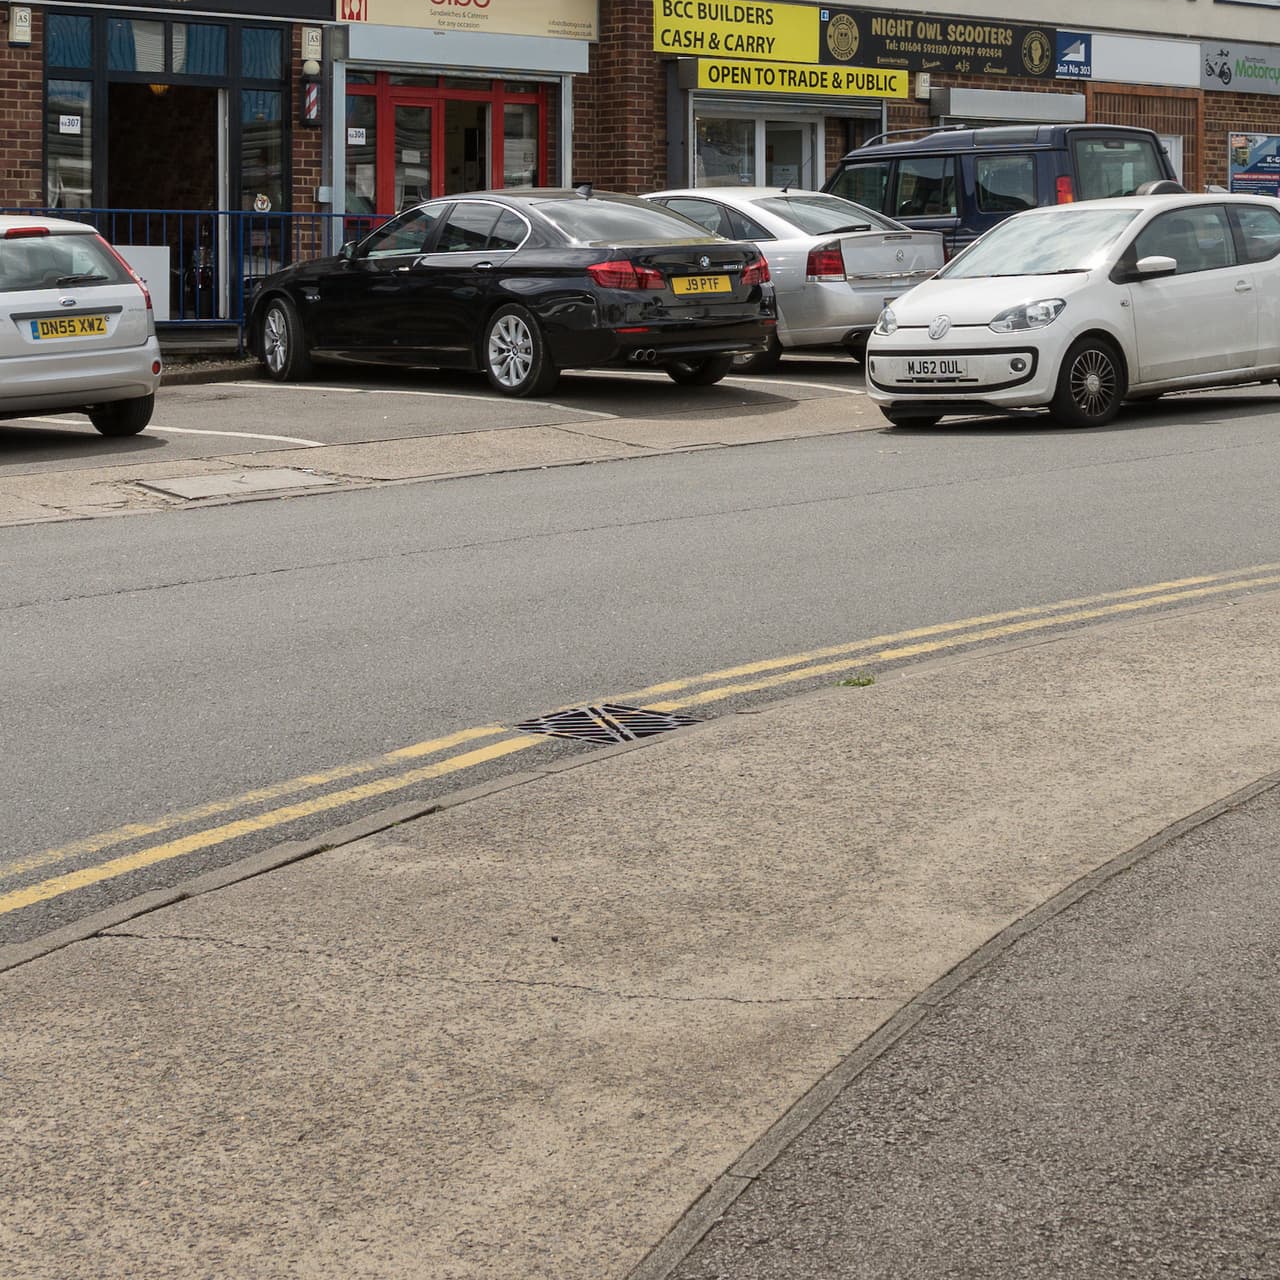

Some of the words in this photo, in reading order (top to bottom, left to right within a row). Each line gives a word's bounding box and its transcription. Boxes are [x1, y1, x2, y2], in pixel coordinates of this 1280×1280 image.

[430, 9, 461, 18] Sandwiches
[467, 11, 488, 20] Caterers
[663, 0, 693, 18] BCC
[698, 3, 774, 25] BUILDERS
[446, 21, 456, 30] any
[872, 18, 914, 37] NIGHT
[917, 21, 943, 41] OWL
[947, 24, 1013, 46] SCOOTERS
[661, 29, 704, 49] CASH
[708, 33, 720, 50] &
[724, 34, 775, 54] CARRY
[885, 39, 899, 51] Tel:
[900, 41, 920, 52] 01604
[1069, 65, 1078, 73] No
[1080, 66, 1090, 75] 303
[708, 65, 751, 85] OPEN
[755, 68, 775, 86] TO
[778, 70, 828, 88] TRADE
[832, 73, 842, 89] &
[847, 74, 897, 92] PUBLIC
[67, 118, 79, 126] 307
[686, 279, 698, 291] J9
[700, 278, 719, 290] PTF
[40, 320, 76, 336] DN55
[80, 318, 104, 332] XWZ
[908, 361, 937, 375] MJ62
[940, 360, 962, 374] OUL
